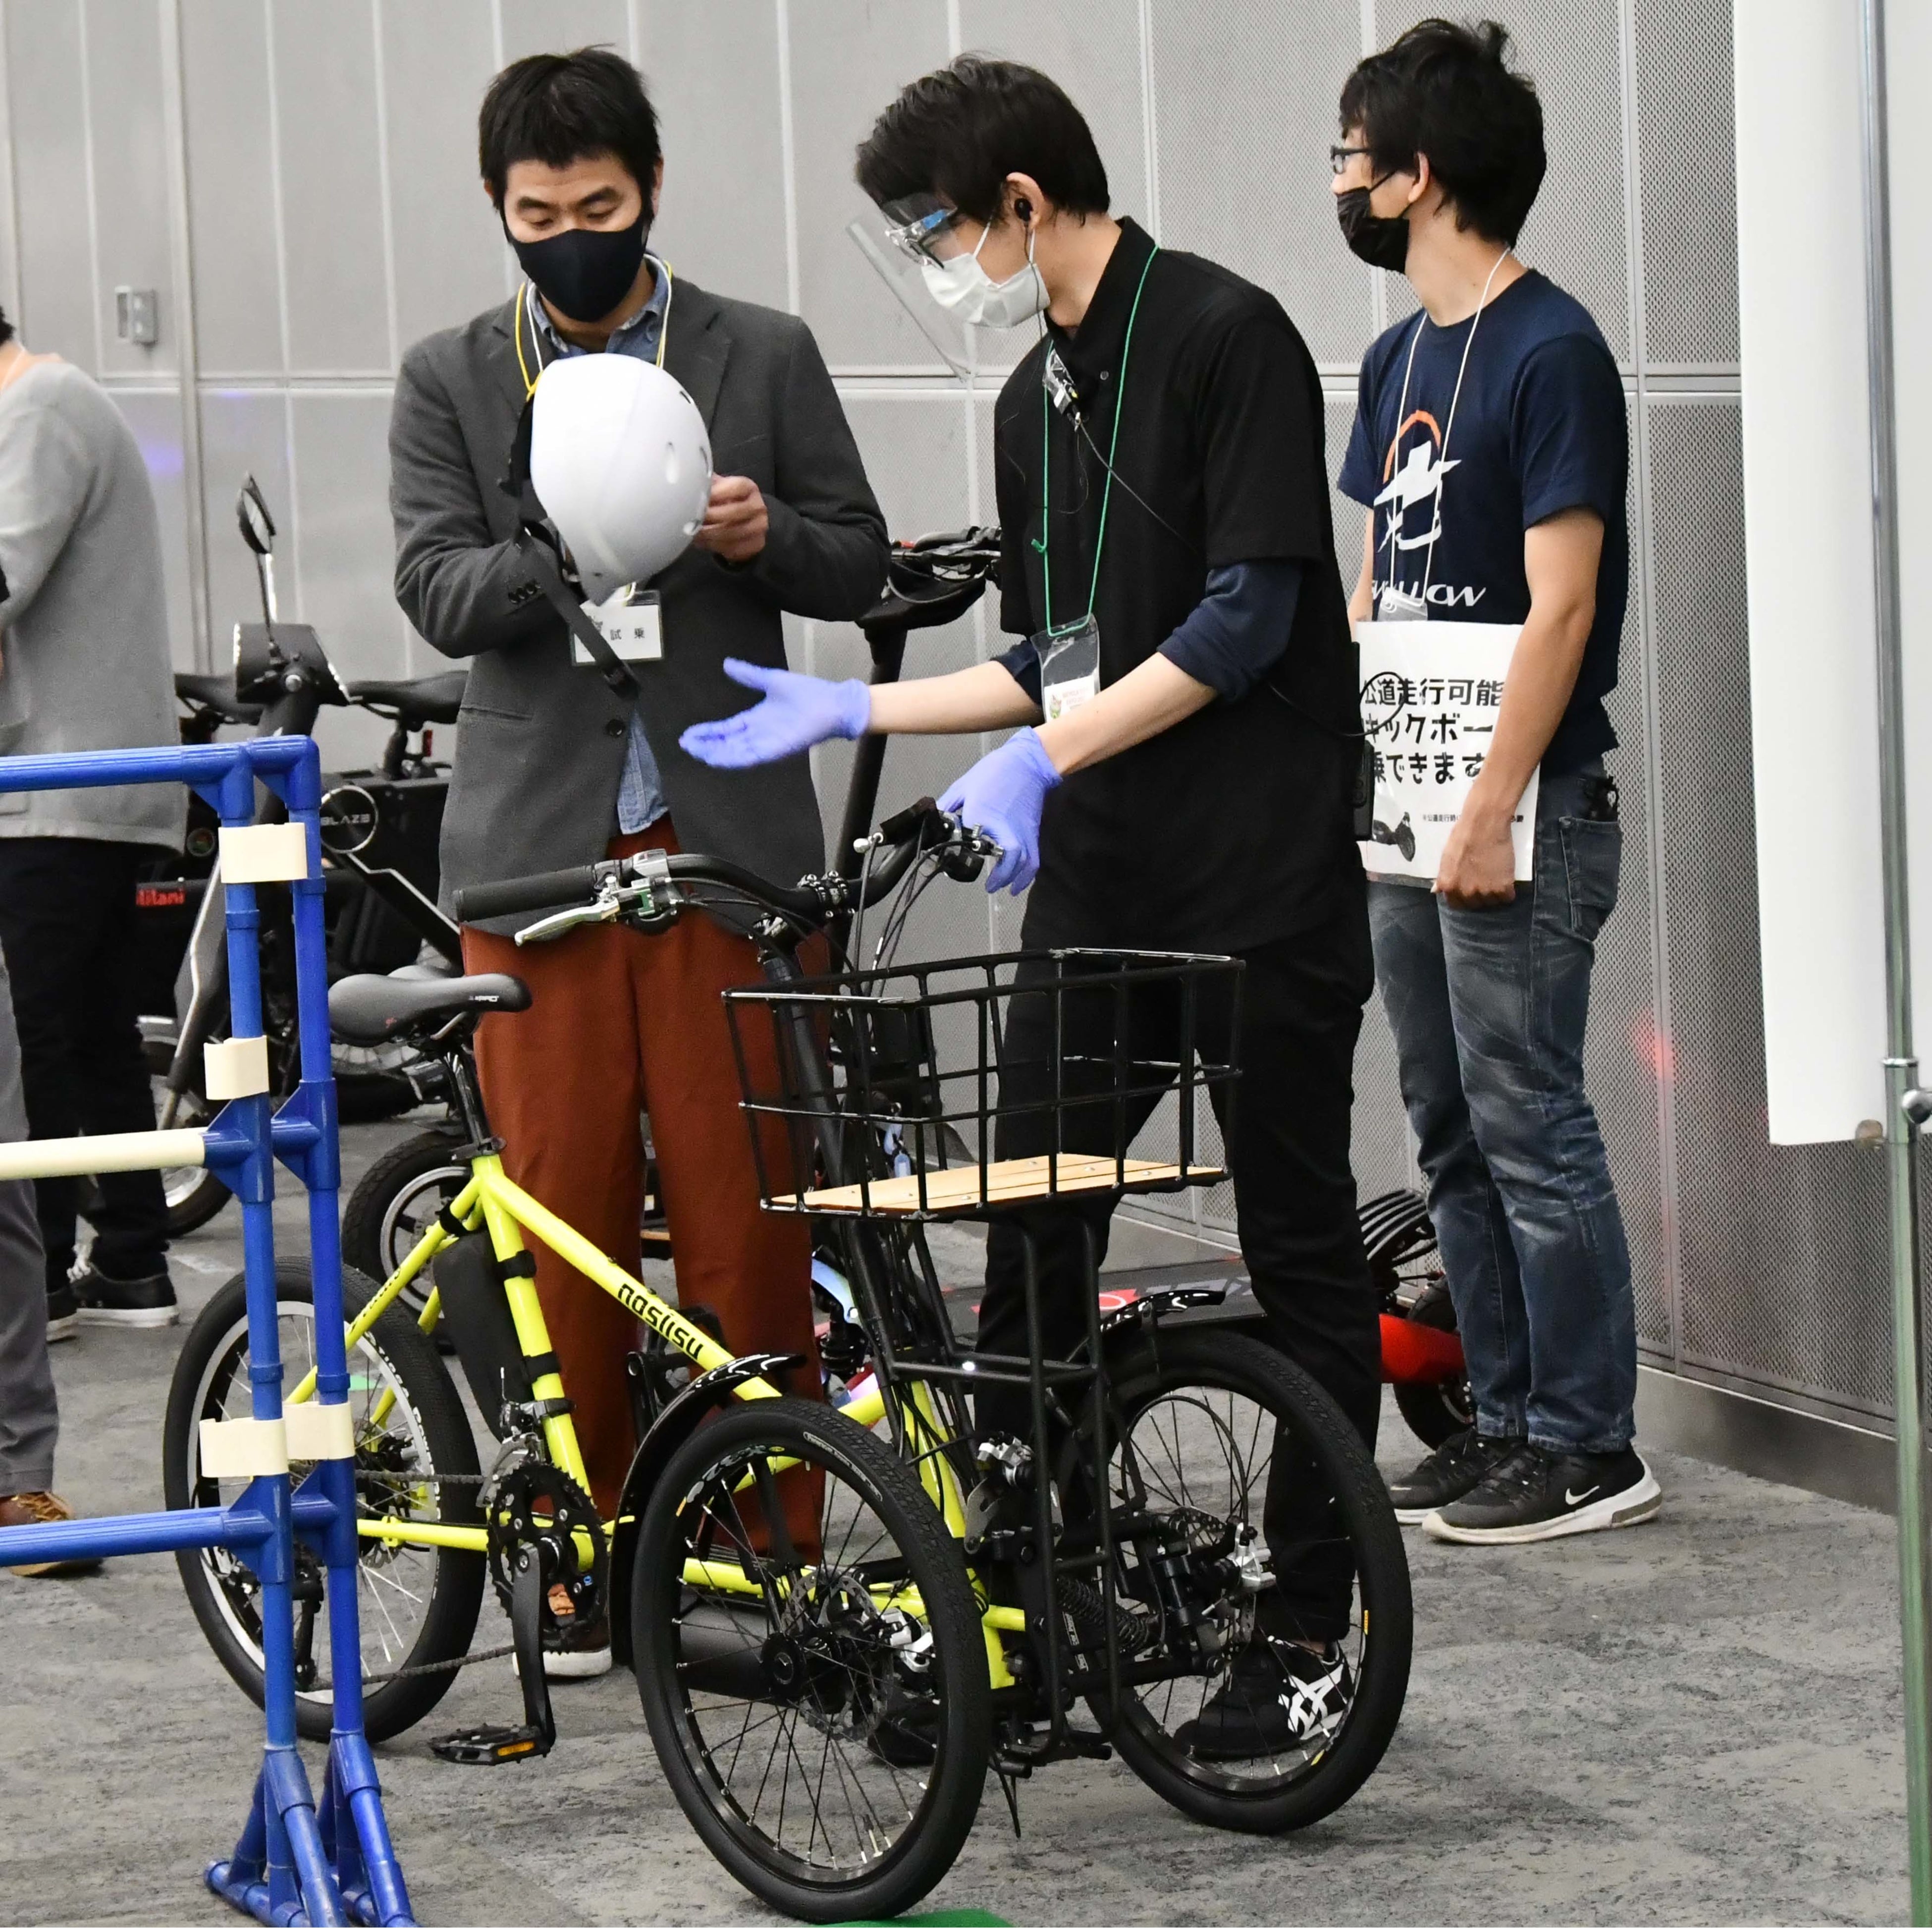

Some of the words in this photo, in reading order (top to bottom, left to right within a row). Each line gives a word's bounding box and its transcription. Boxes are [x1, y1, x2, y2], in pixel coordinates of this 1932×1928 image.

[1365, 678, 1504, 706] 公道走行可能
